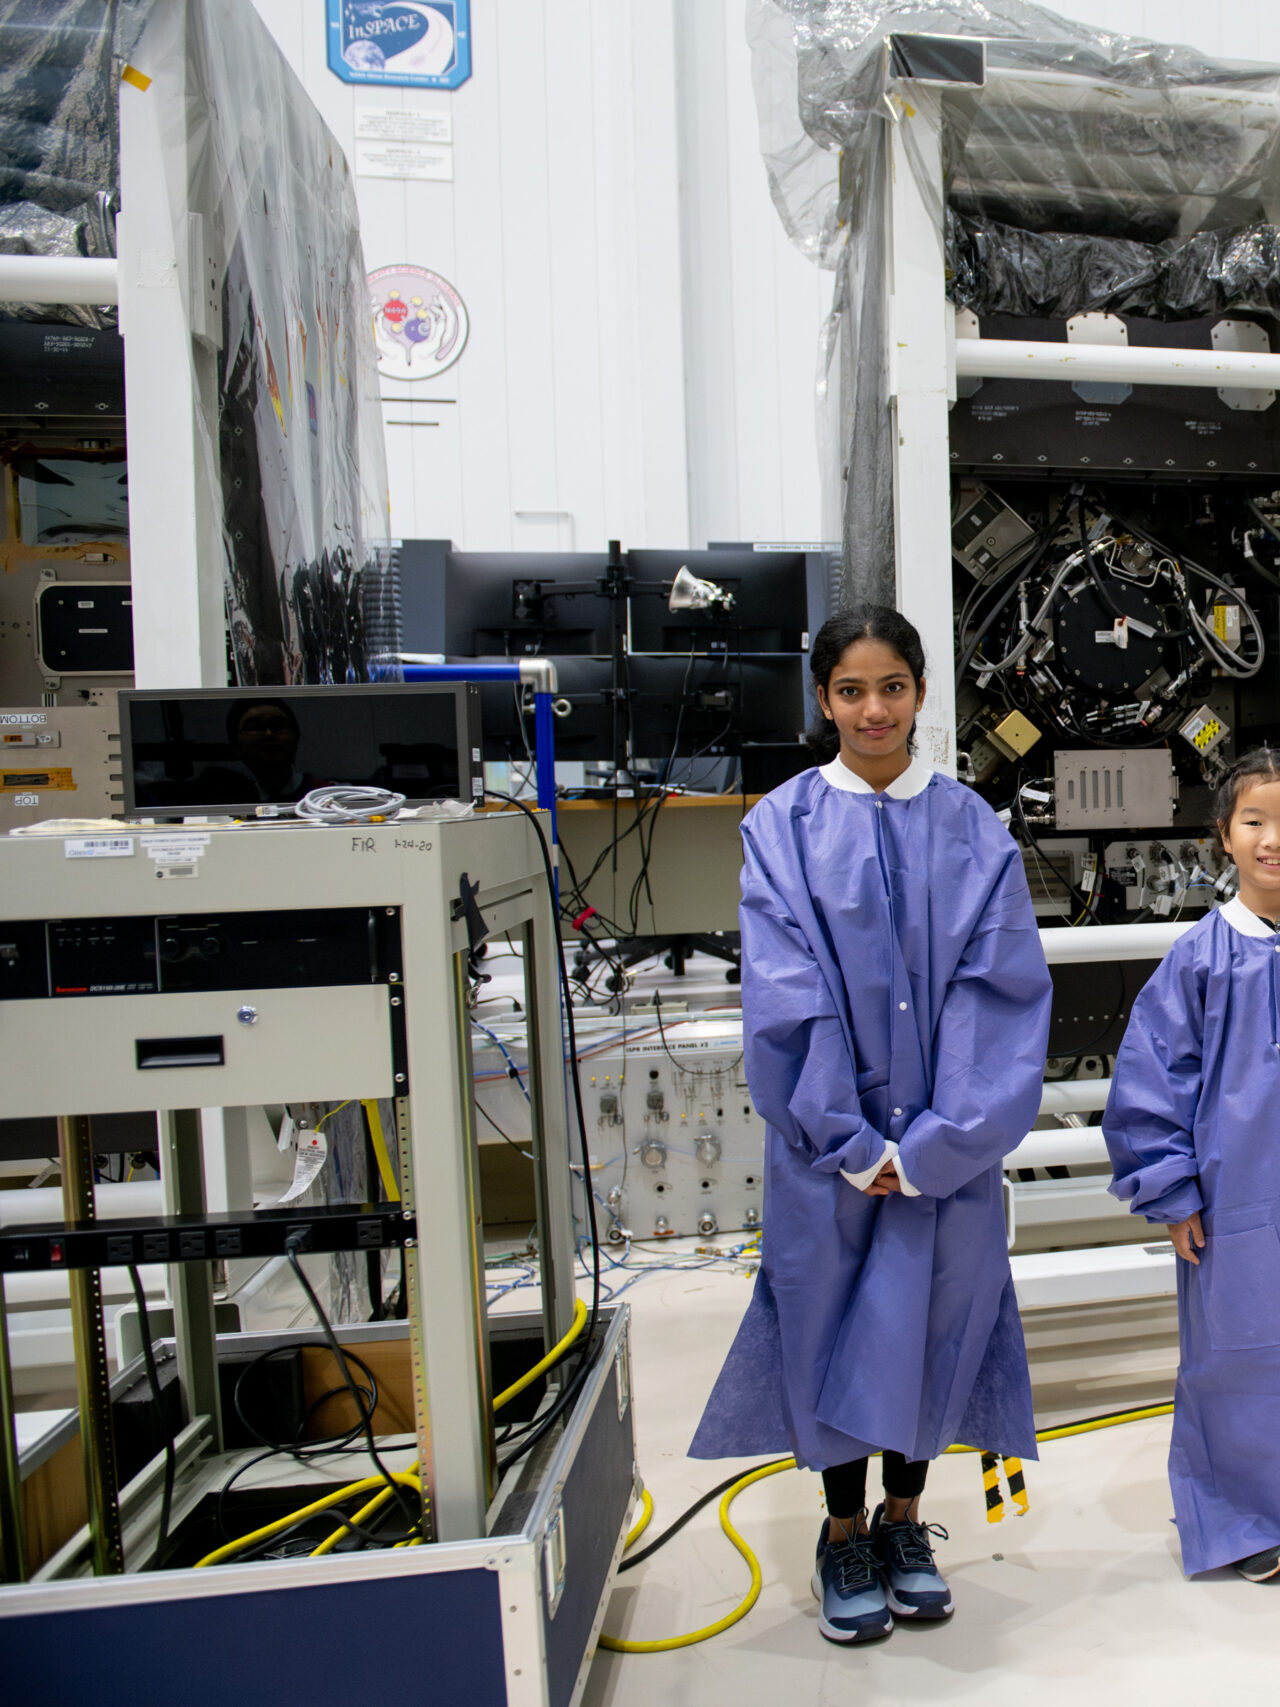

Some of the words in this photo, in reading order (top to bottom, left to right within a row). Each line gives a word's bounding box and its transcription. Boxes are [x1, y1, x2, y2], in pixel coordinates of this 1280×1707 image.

[0, 714, 46, 724] BOTTOM
[15, 796, 38, 805] TOP
[351, 837, 376, 853] FIR
[642, 1044, 676, 1052] INTERFCE
